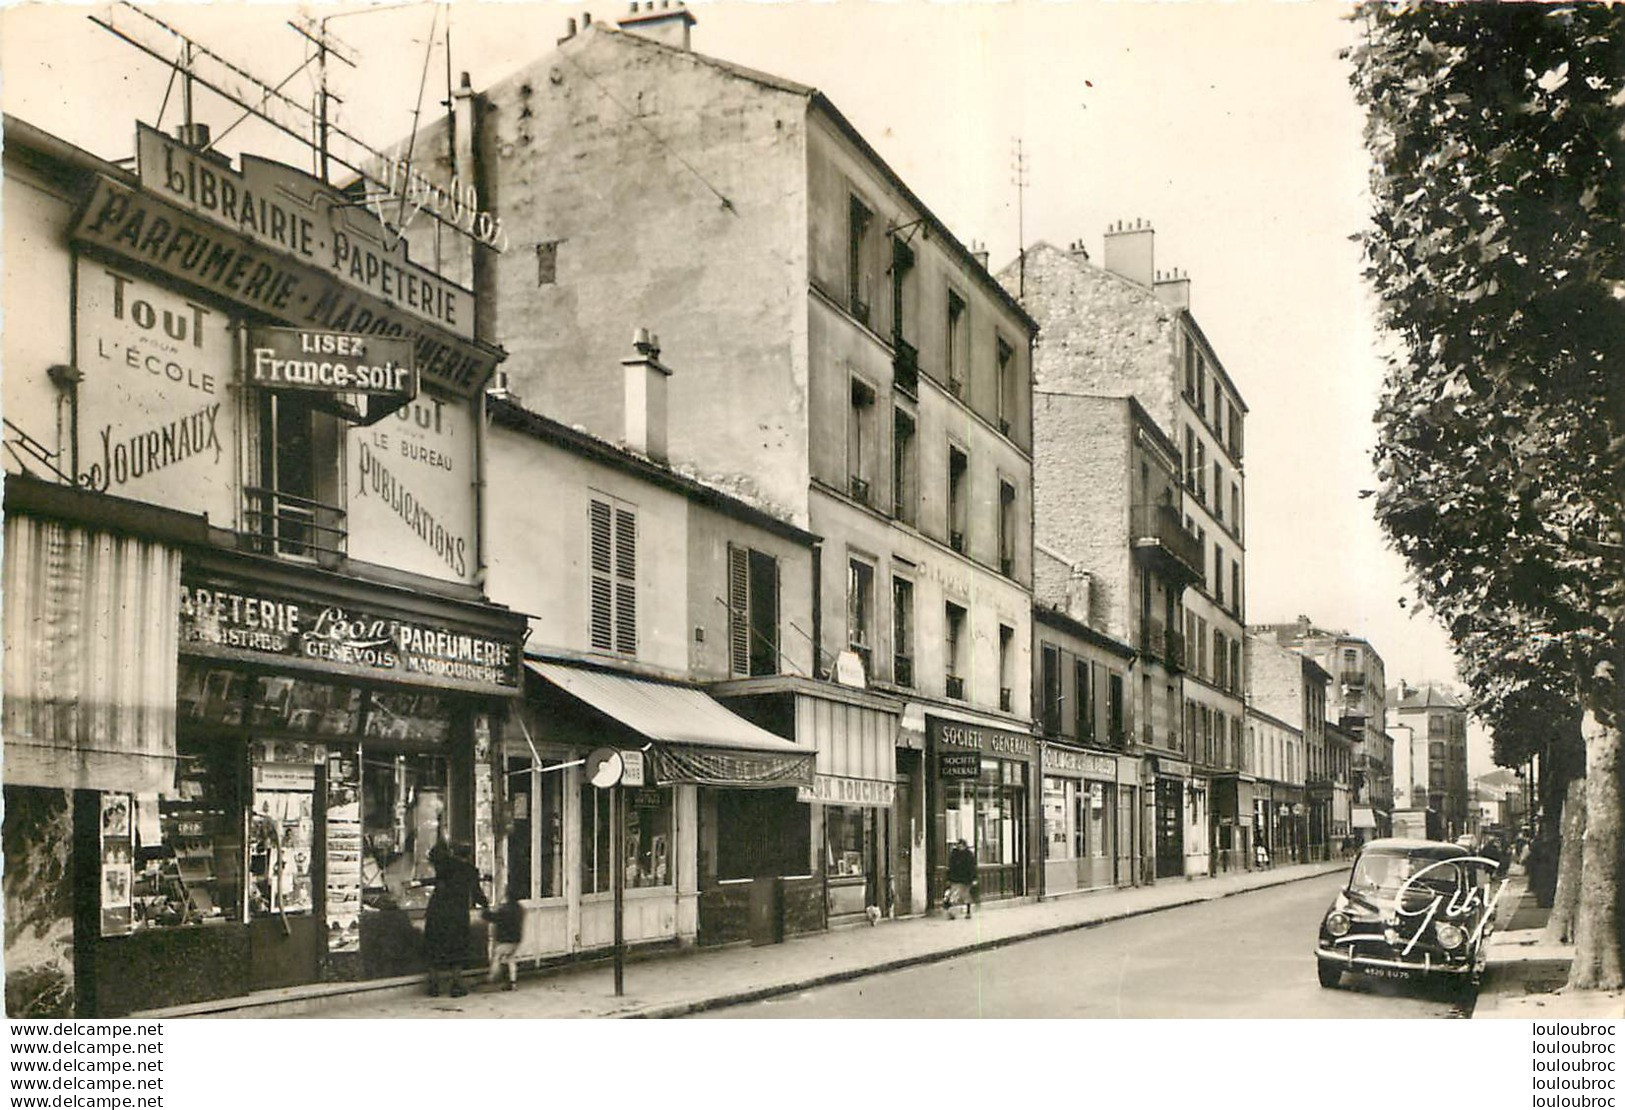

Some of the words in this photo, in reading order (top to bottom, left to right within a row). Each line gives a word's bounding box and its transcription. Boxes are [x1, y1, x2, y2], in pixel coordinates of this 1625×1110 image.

[87, 187, 300, 308] PARFUMERIE
[163, 143, 314, 257] LIBRAIRIE
[332, 231, 456, 326] PAPETERIE
[302, 333, 364, 357] LISEZ
[254, 347, 409, 391] France-soir
[80, 403, 222, 493] JOURNAUX
[373, 431, 389, 450] LE
[401, 440, 453, 472] BUREAU
[355, 437, 466, 578] PUBLICATIONS
[306, 640, 395, 668] GENEVOIS
[400, 625, 511, 667] PARFUMERIE
